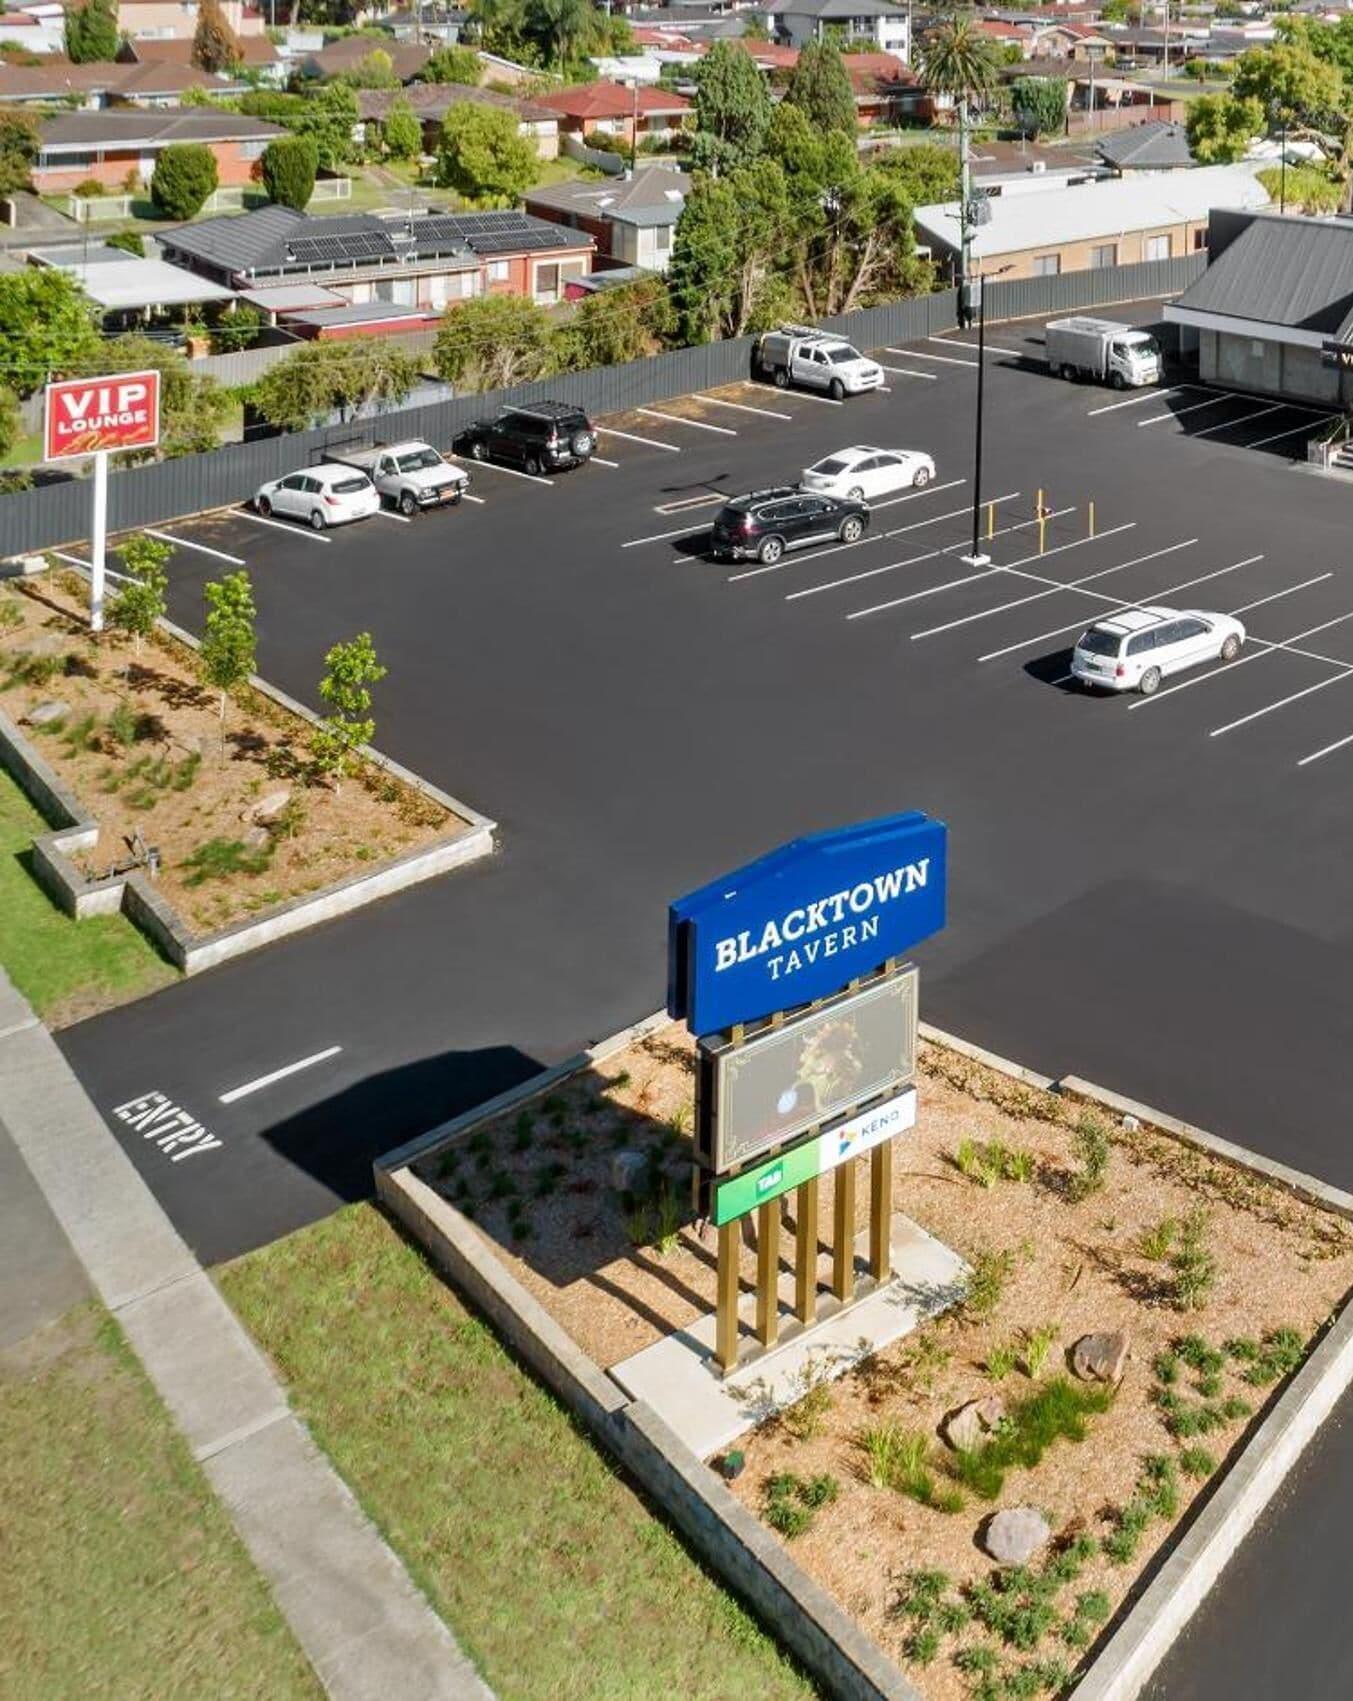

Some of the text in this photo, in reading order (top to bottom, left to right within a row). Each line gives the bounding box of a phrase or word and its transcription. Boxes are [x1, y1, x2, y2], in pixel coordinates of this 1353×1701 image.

[61, 384, 147, 418] VIP
[58, 410, 147, 434] LOUNGE
[714, 858, 930, 972] BLACKTOWN
[767, 916, 880, 980] TAVERN
[112, 1091, 223, 1162] ENTRY
[860, 1110, 900, 1137] KENO
[757, 1170, 782, 1192] TAB
